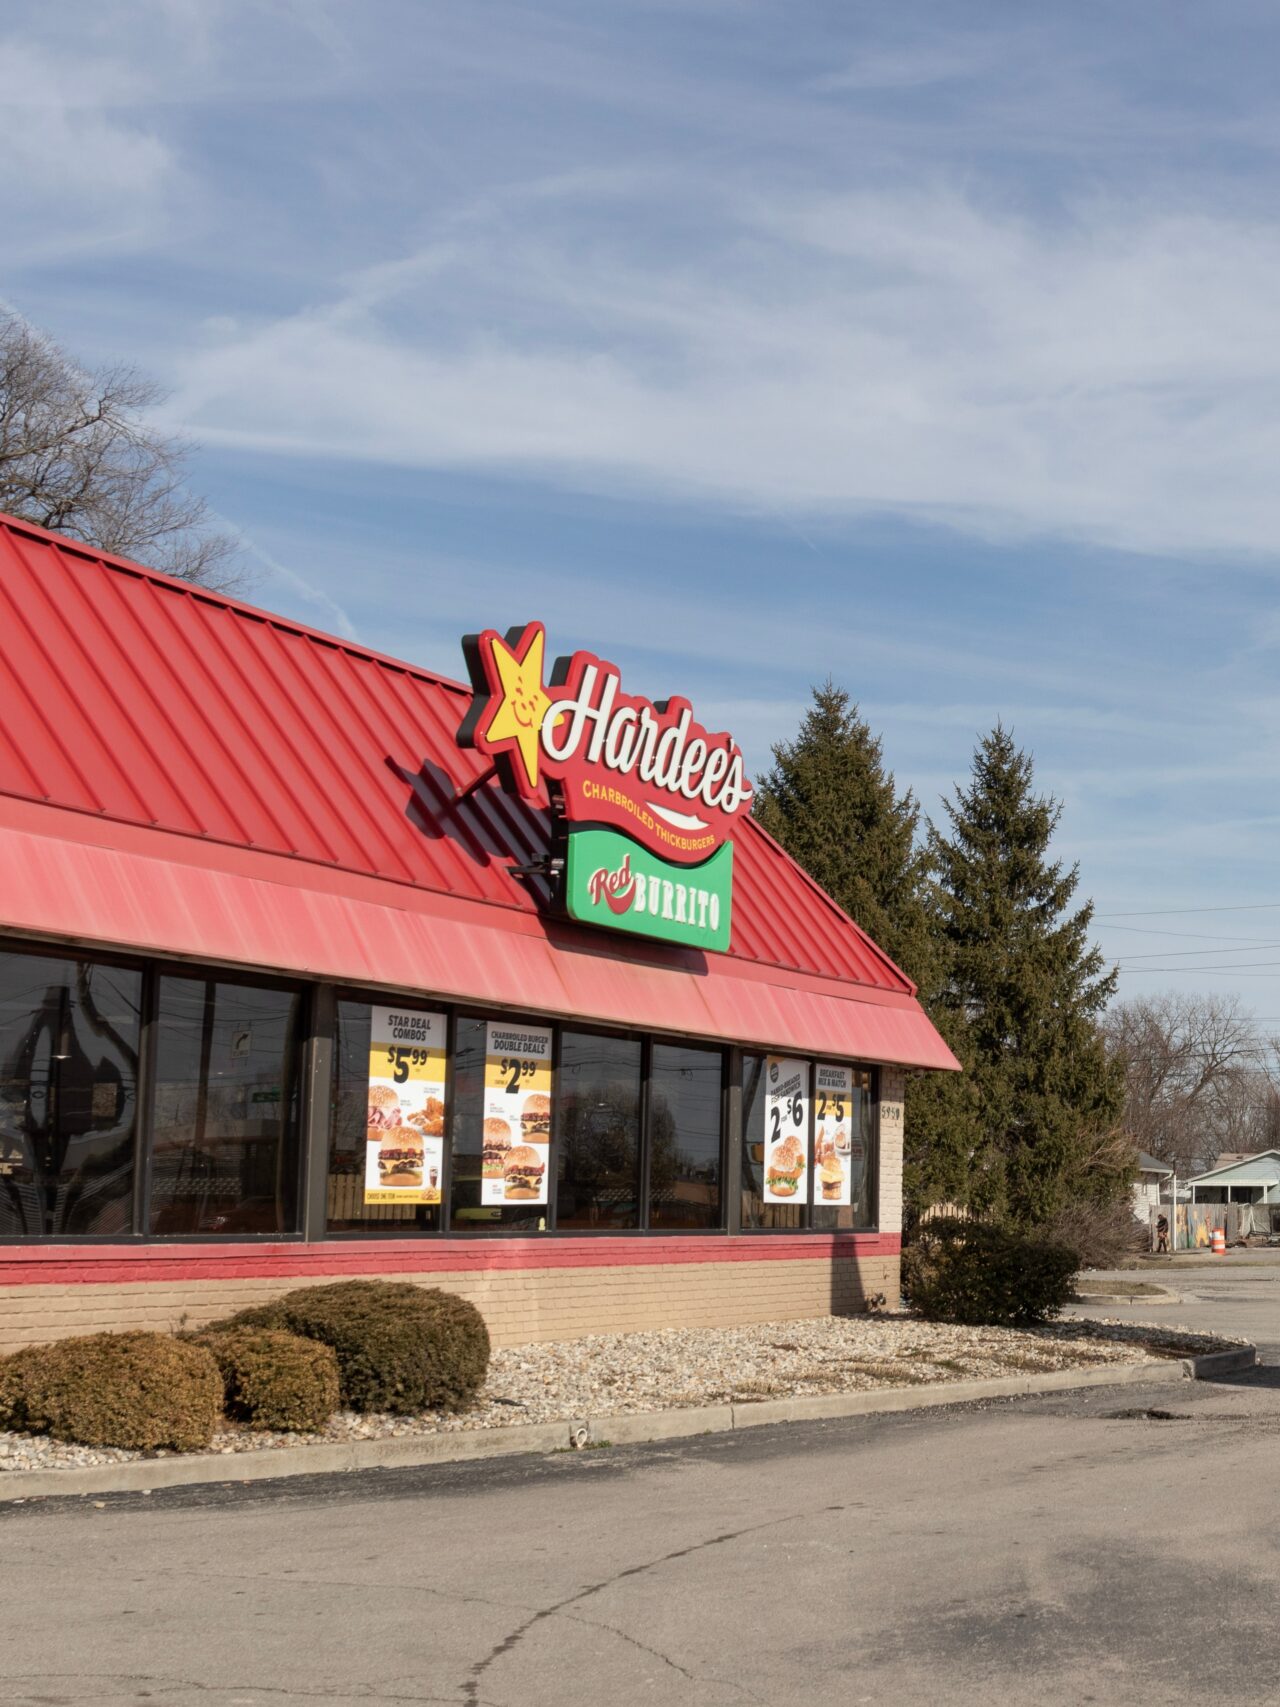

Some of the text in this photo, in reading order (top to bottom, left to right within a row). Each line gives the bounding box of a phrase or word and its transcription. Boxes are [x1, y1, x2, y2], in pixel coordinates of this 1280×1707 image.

[542, 663, 752, 813] Hardee's
[583, 780, 715, 850] CHARBROILED THICKBURGERS
[588, 853, 720, 931] Red BURRITO
[388, 1014, 431, 1030] STAR DEAL
[393, 1028, 426, 1041] COMBOS
[494, 1039, 545, 1054] DOUBLE DEALS
[771, 1106, 781, 1143] 2
[787, 1090, 803, 1127] $6
[817, 1091, 846, 1122] 2 $5
